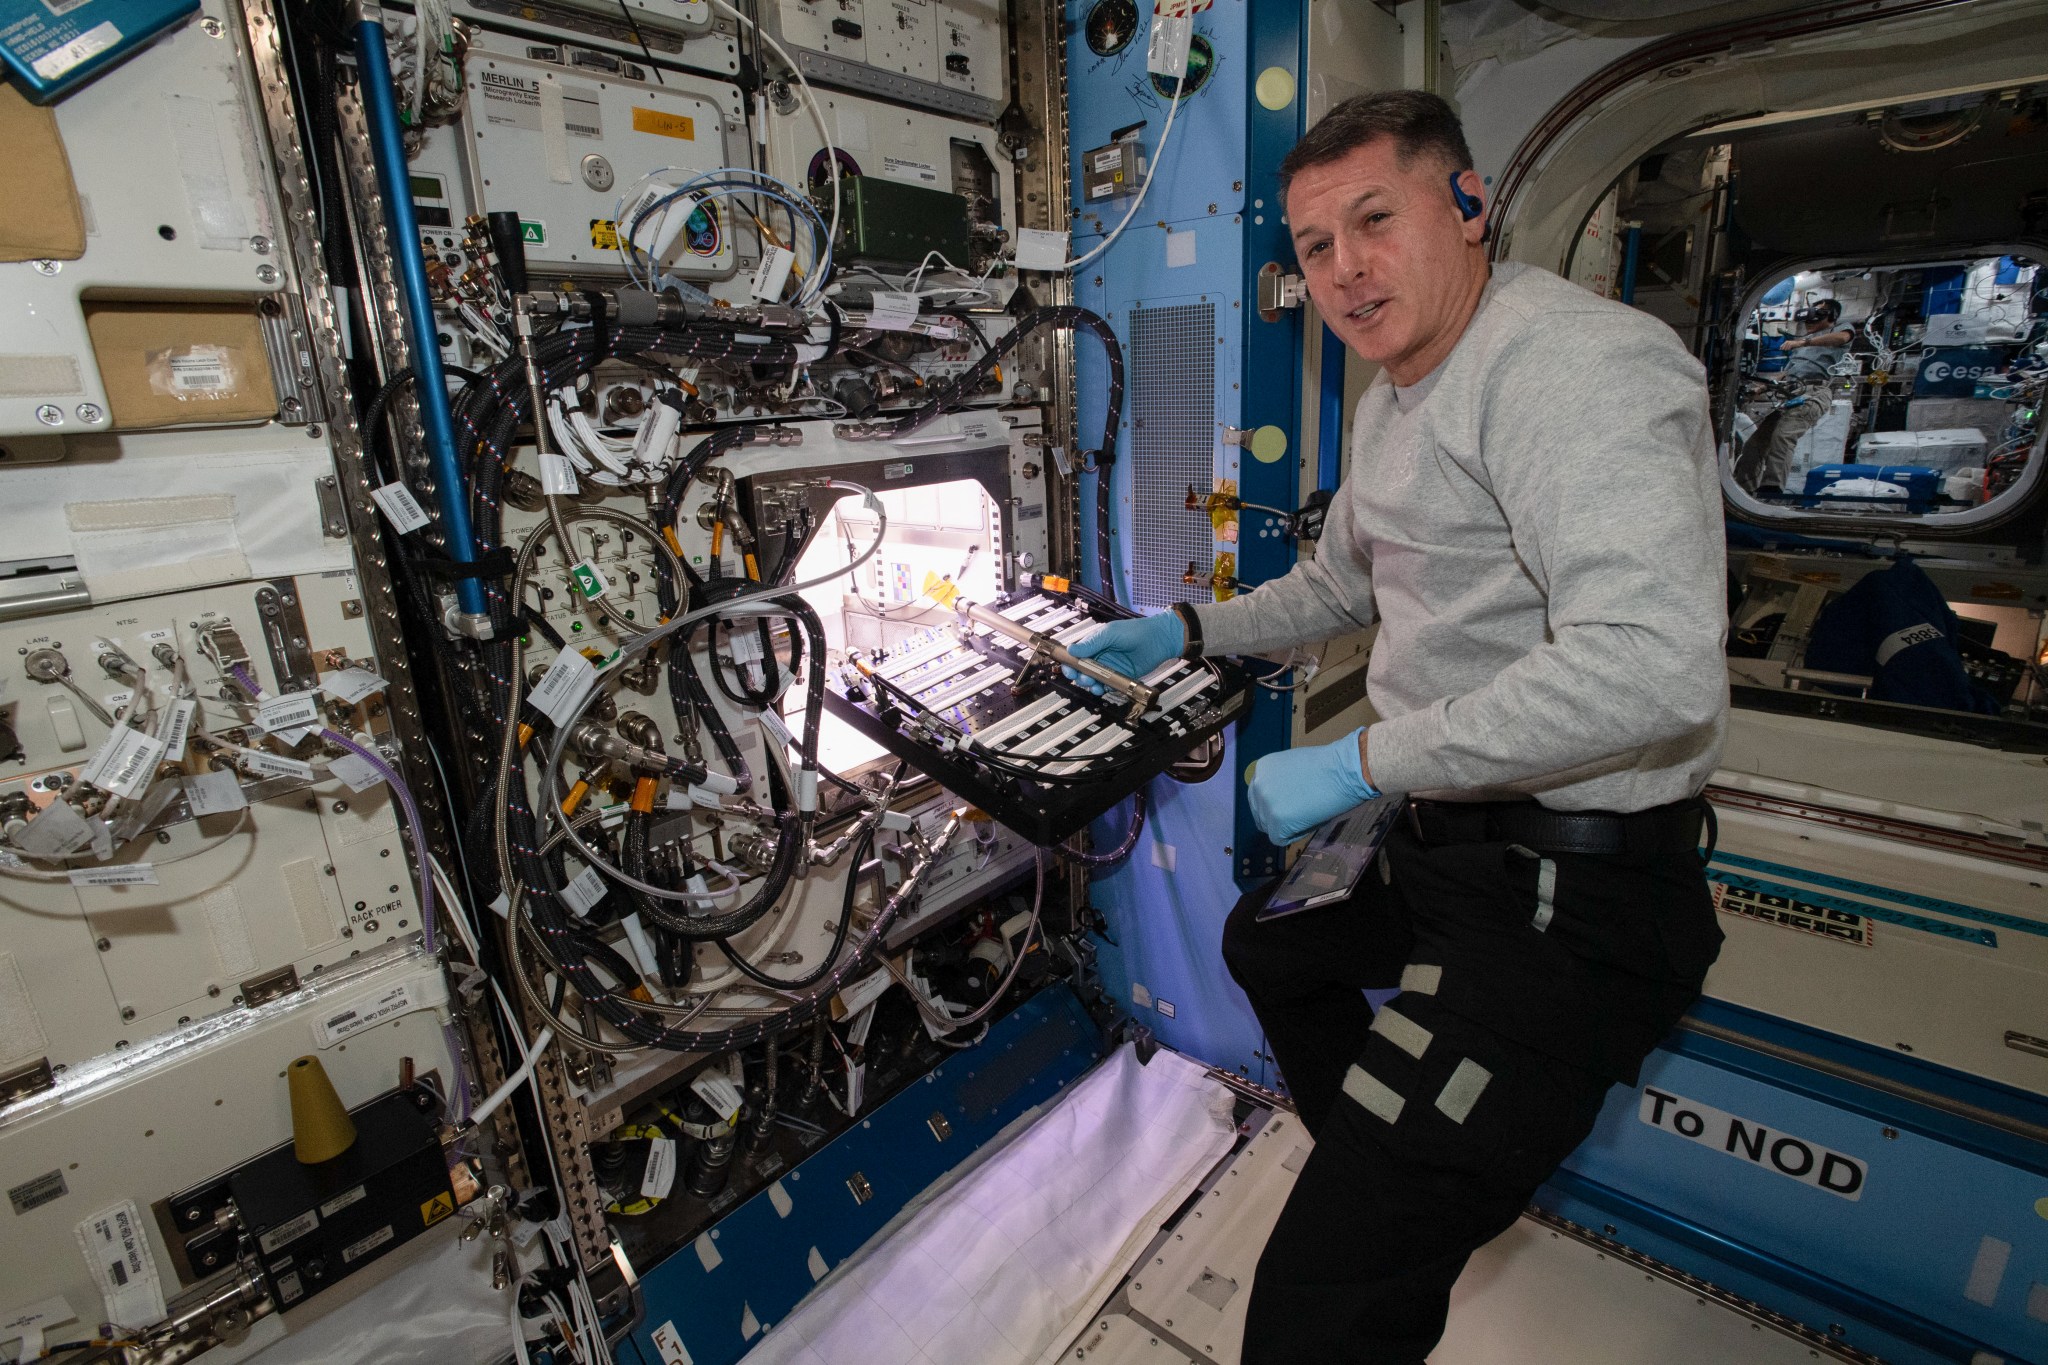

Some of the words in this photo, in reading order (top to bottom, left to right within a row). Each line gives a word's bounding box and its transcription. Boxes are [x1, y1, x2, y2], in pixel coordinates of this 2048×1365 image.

[481, 71, 524, 88] MERLIN
[532, 81, 540, 91] 5
[483, 85, 522, 99] (Microgravity
[484, 93, 513, 102] Research
[511, 526, 534, 534] POWER
[116, 618, 138, 626] NTSC
[545, 613, 567, 622] TATUS
[26, 636, 50, 645] LAN2
[151, 631, 165, 639] Ch3
[1901, 628, 1944, 648] 5884
[205, 676, 228, 685] VIDEO
[112, 694, 128, 702] Ch2
[351, 911, 374, 925] RACK
[376, 899, 403, 916] POWER
[389, 998, 408, 1010] MSPR2
[363, 1012, 378, 1022] Cable
[336, 1024, 350, 1034] Strap
[1645, 1088, 1705, 1139] To
[1725, 1119, 1863, 1195] NOD
[114, 1211, 129, 1228] MSPR2
[123, 1237, 136, 1251] Cable
[281, 1274, 295, 1285] ON
[285, 1288, 301, 1301] OFF
[655, 1331, 667, 1350] F
[671, 1341, 682, 1355] 1
